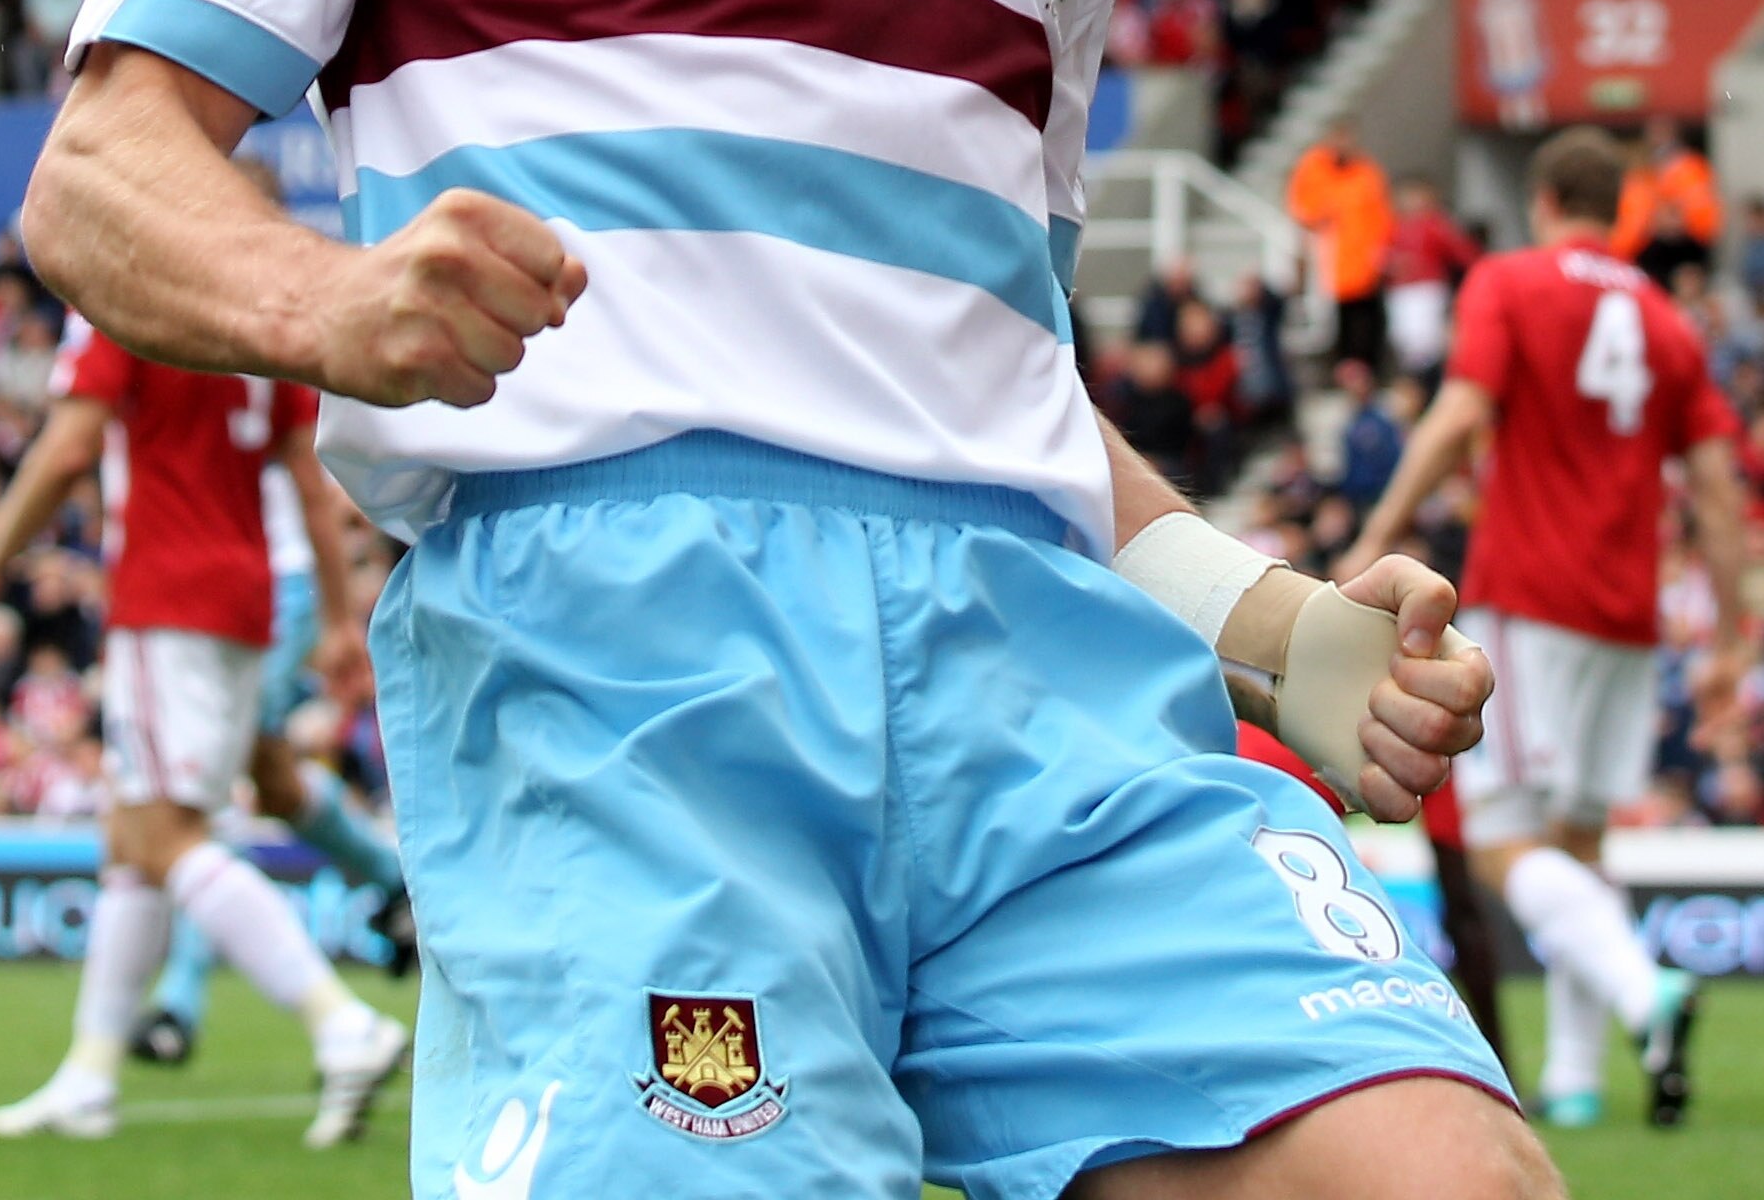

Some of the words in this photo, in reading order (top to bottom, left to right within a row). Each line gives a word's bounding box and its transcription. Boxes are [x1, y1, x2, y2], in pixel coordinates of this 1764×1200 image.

[1575, 291, 1655, 437] 4
[1250, 825, 1400, 962] 8
[648, 1096, 693, 1129] WEST
[692, 1116, 730, 1137] HAM
